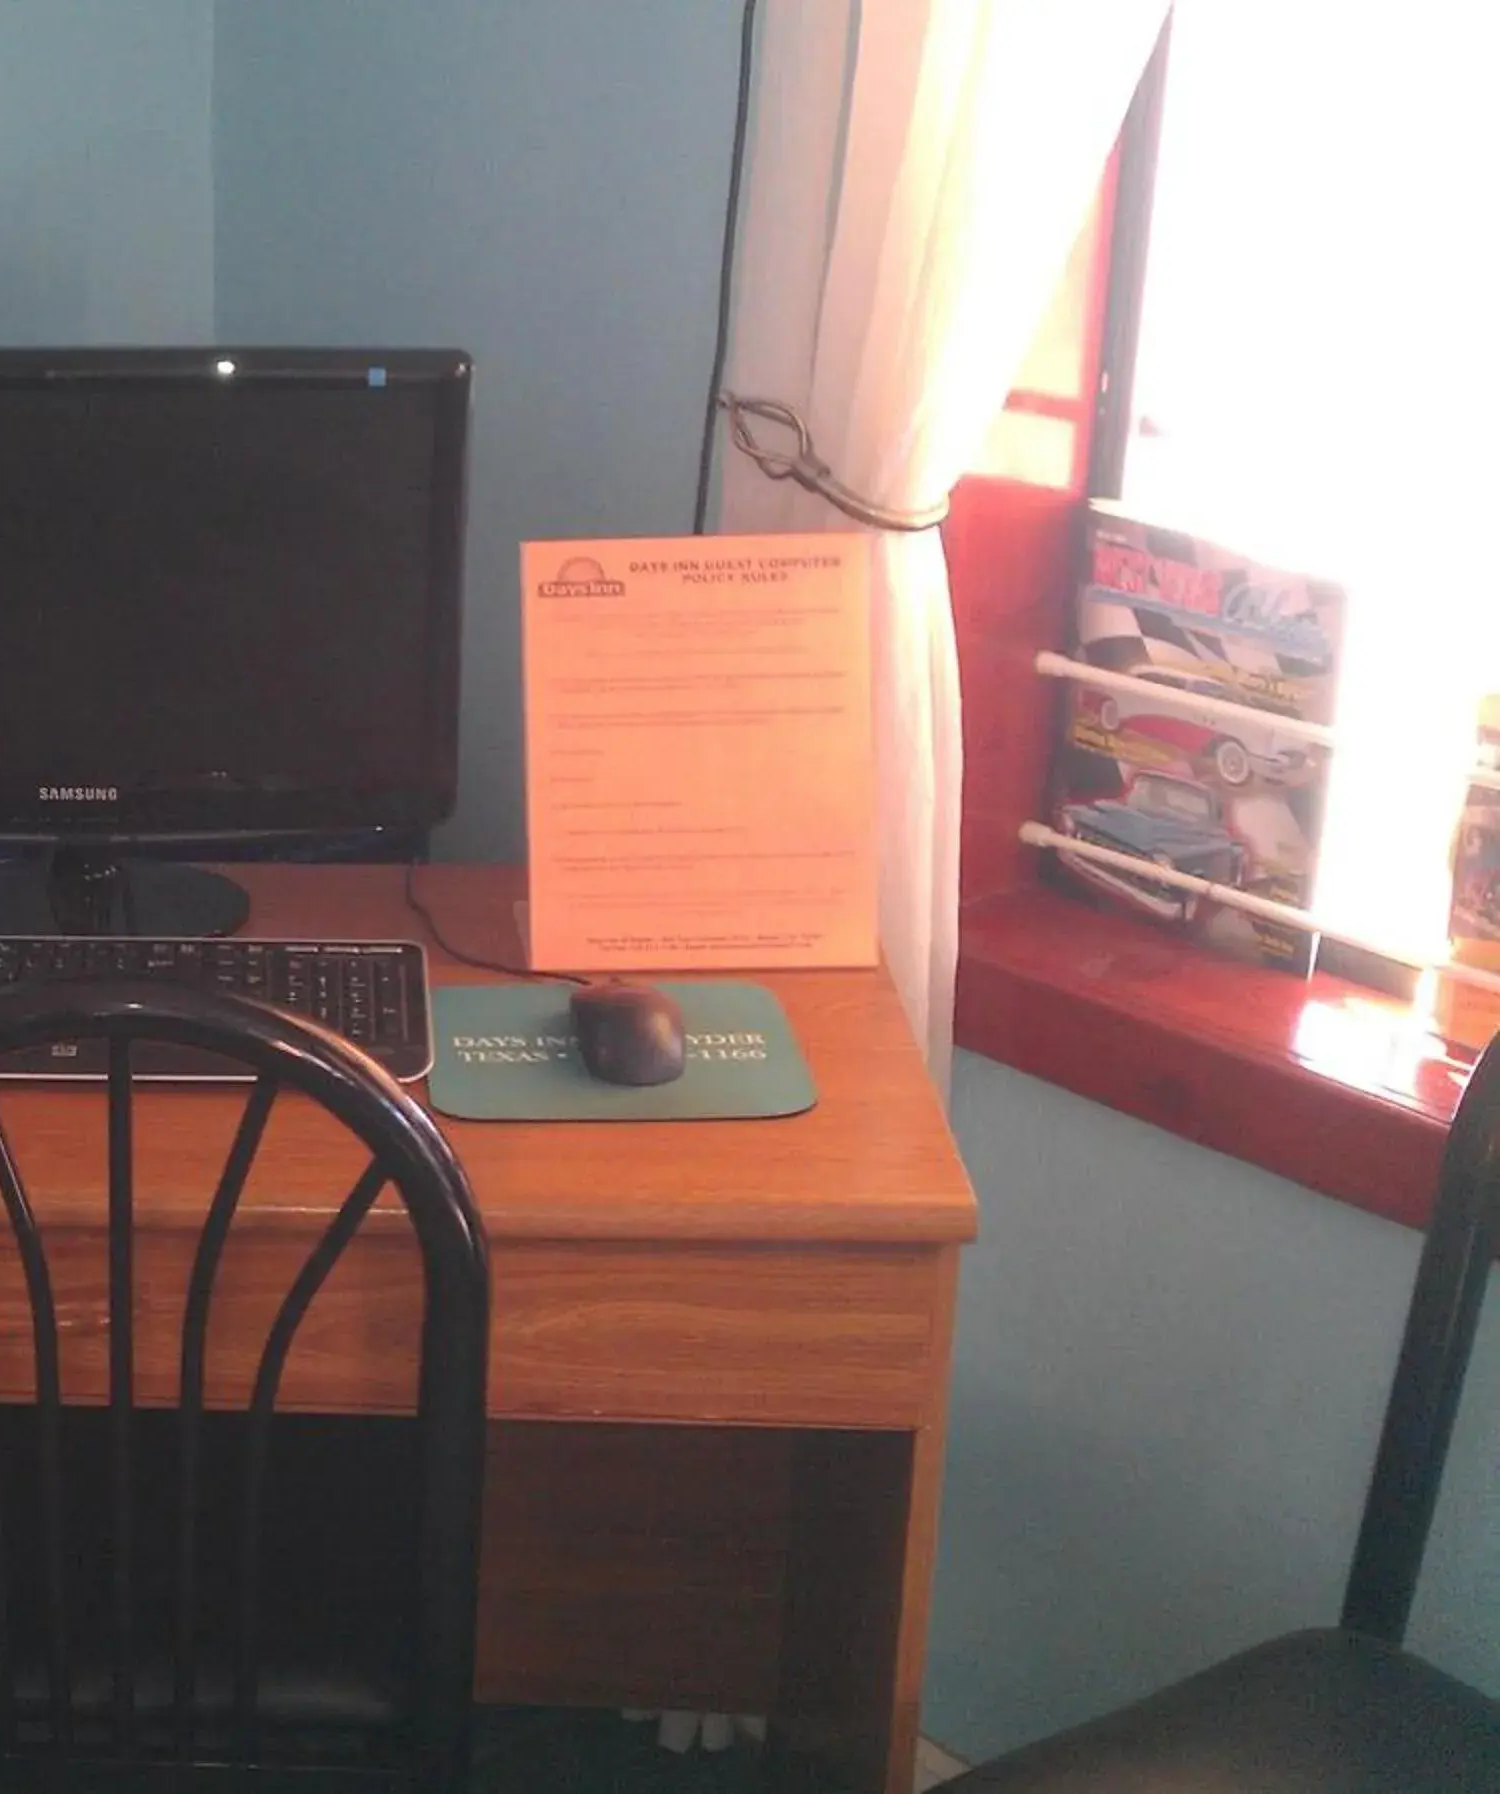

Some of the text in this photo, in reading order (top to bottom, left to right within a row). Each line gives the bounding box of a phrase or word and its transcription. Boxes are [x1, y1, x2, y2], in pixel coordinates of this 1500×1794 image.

[39, 787, 118, 800] SAMSUNG
[453, 1035, 529, 1047] DAYS
[456, 1050, 550, 1063] TEXAS
